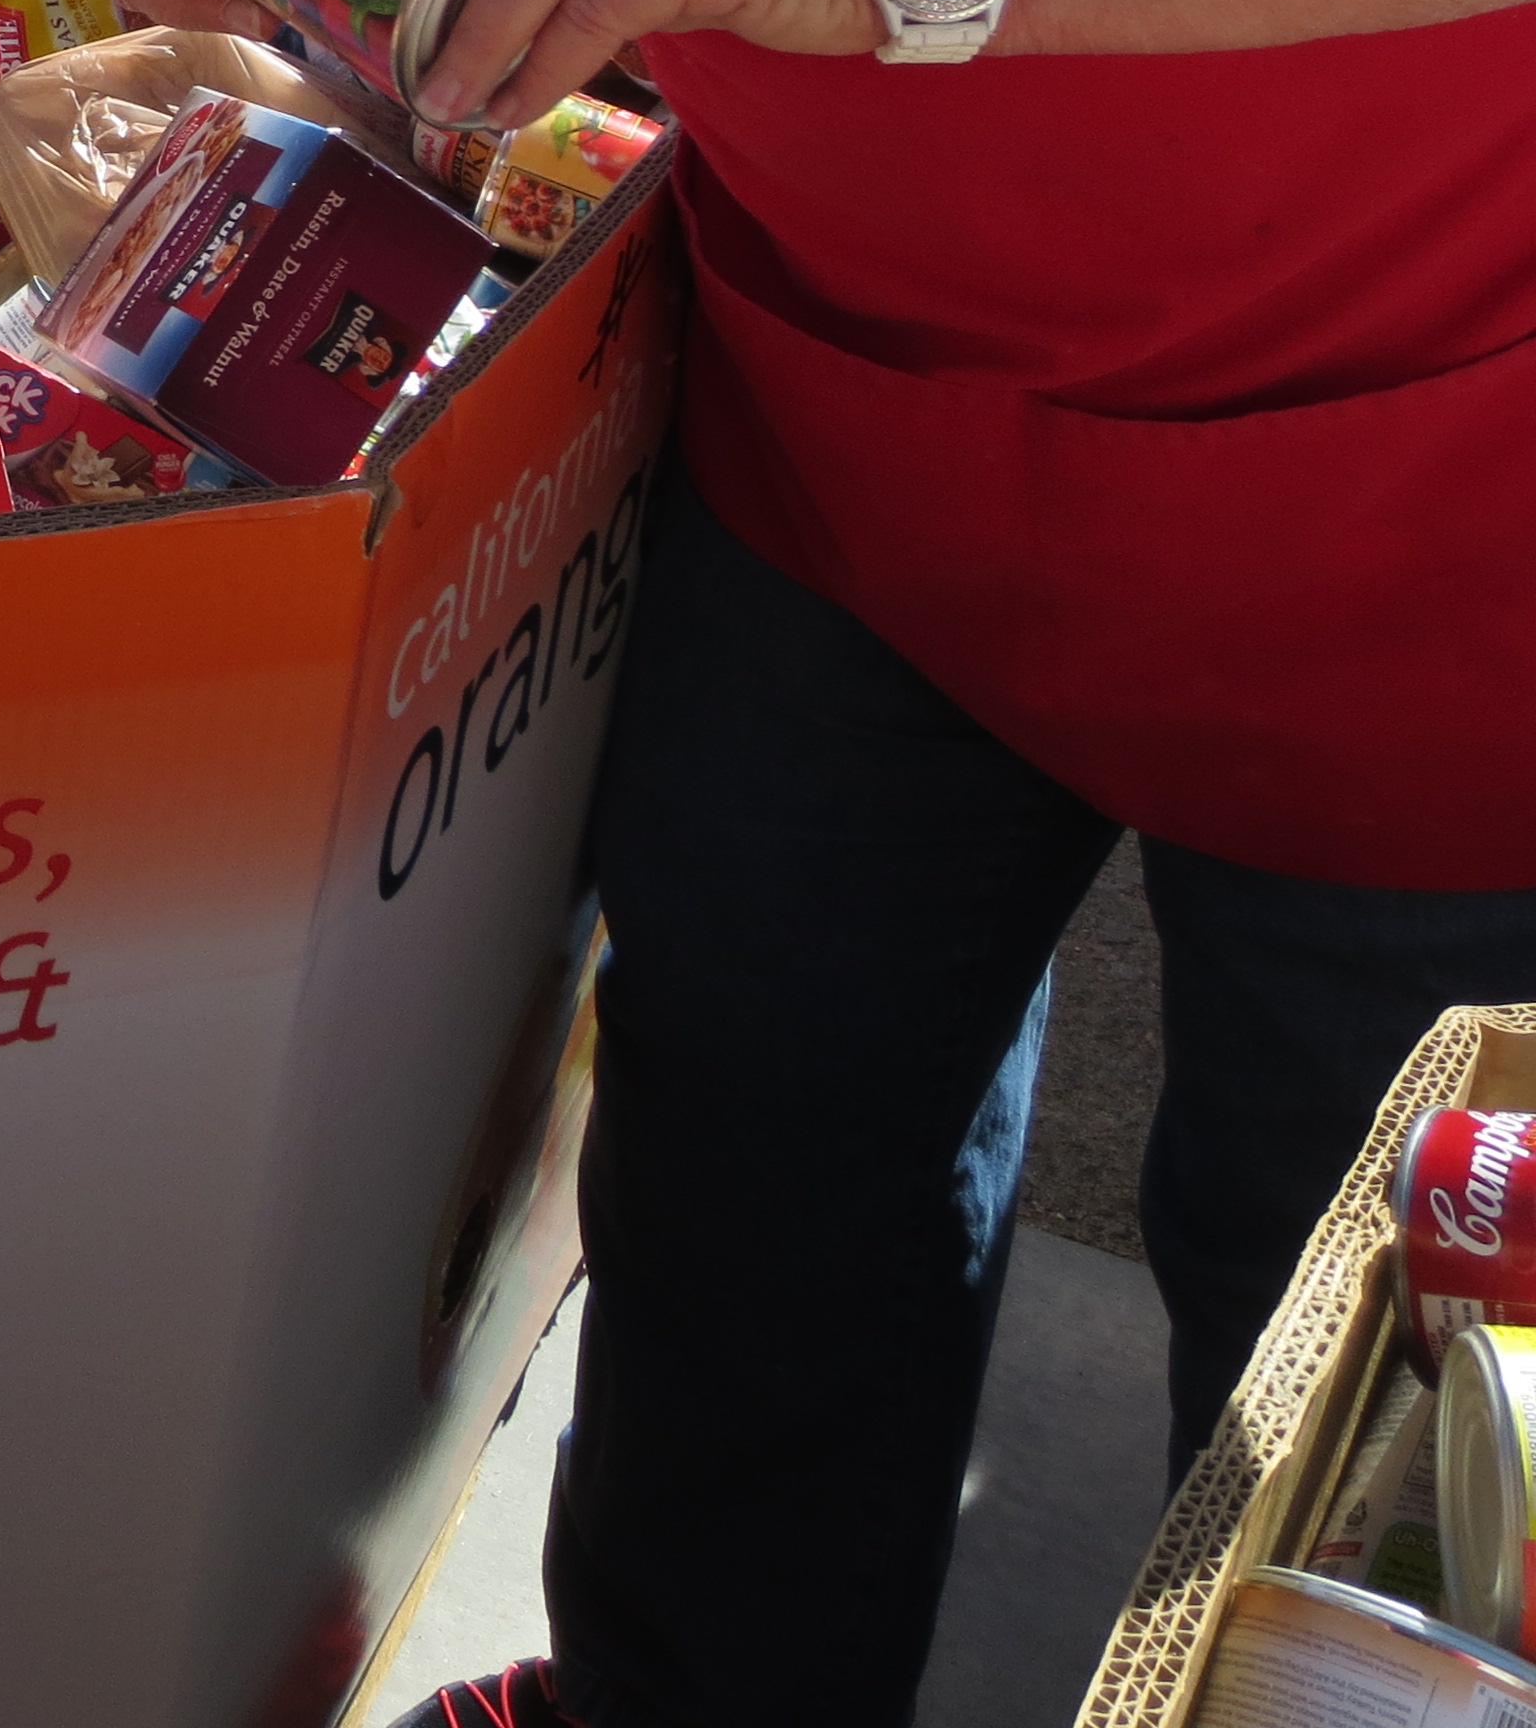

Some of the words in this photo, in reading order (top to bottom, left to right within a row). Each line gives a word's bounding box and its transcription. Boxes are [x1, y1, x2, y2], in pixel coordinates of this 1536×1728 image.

[168, 200, 248, 301] QUAKER
[291, 189, 347, 253] Raisin,
[261, 256, 302, 300] Date
[306, 256, 350, 313] INSTANT
[252, 299, 272, 322] &
[268, 309, 311, 368] OATMEAL
[319, 303, 375, 374] QUAKER
[202, 318, 260, 388] Walnut
[385, 356, 644, 720] california
